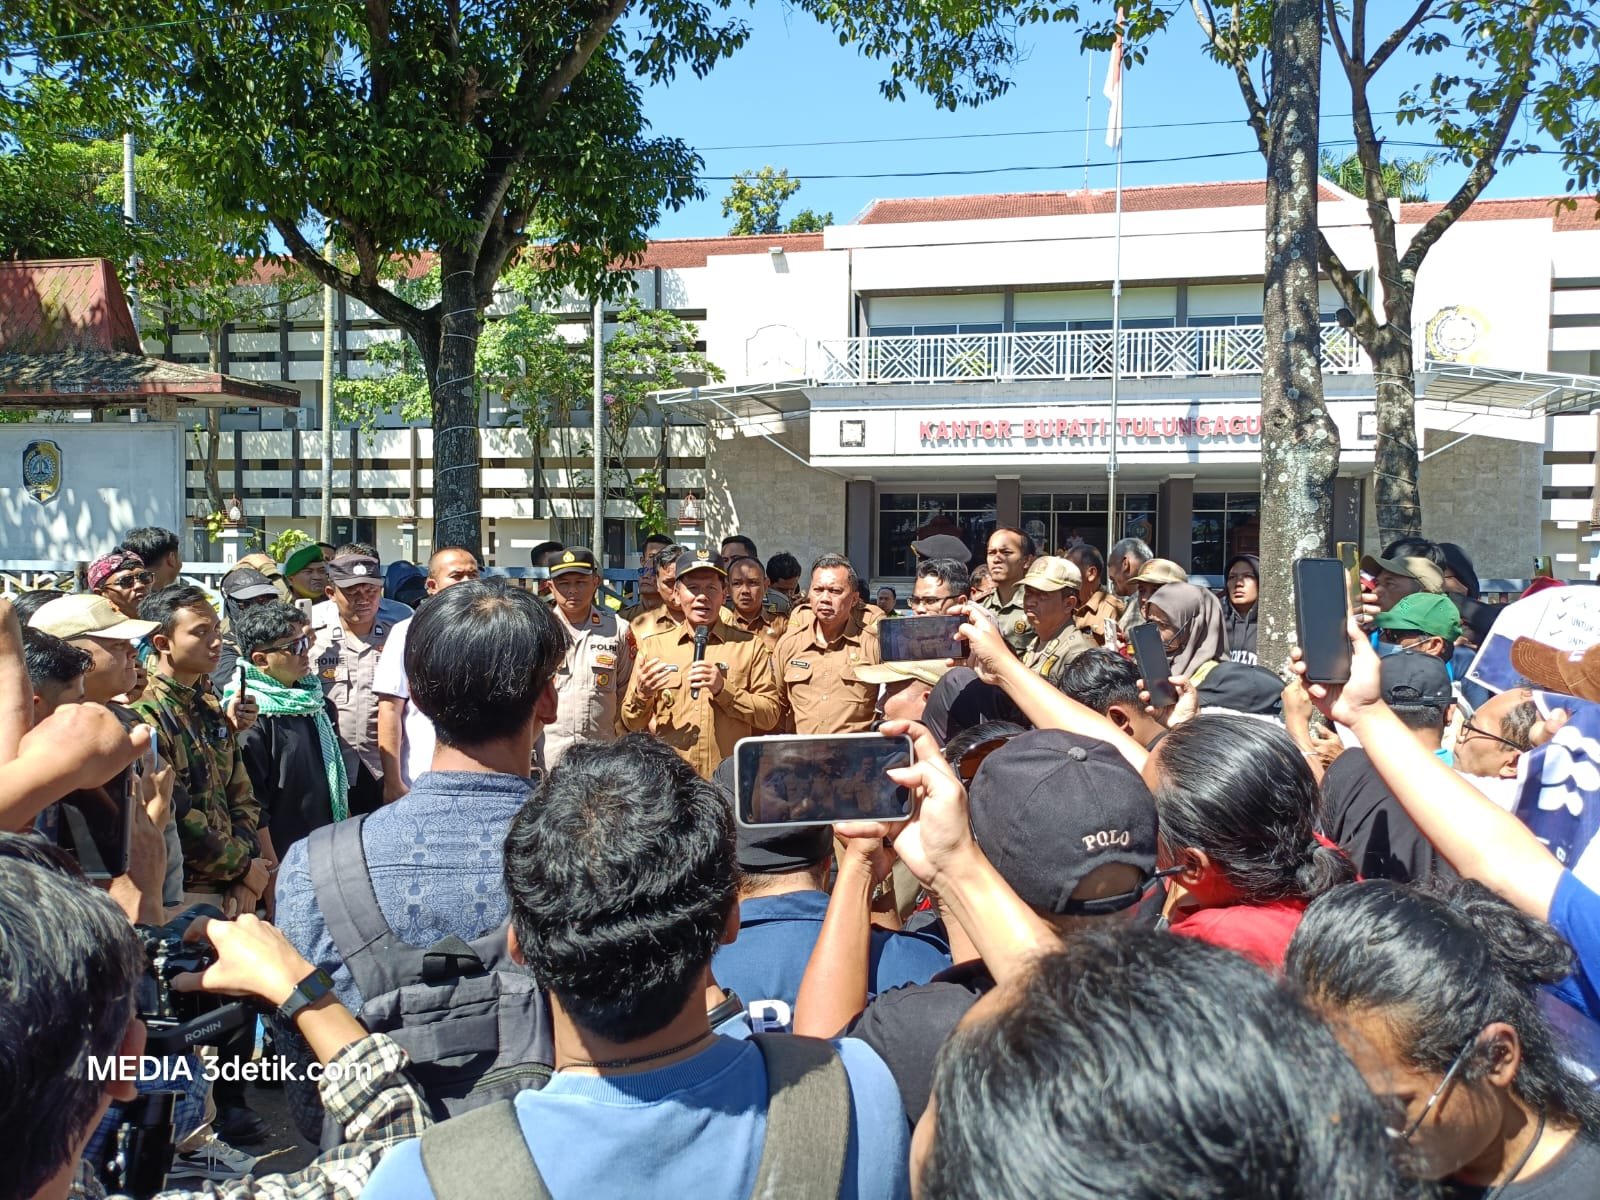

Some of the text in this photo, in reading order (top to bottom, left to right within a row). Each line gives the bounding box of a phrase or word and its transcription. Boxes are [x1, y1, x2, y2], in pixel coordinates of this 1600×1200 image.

[919, 416, 1262, 440] KANTOR BUPATI TULUNGAGU
[590, 643, 617, 652] POLRI
[1081, 829, 1130, 852] POLO
[184, 1020, 222, 1043] RONIN
